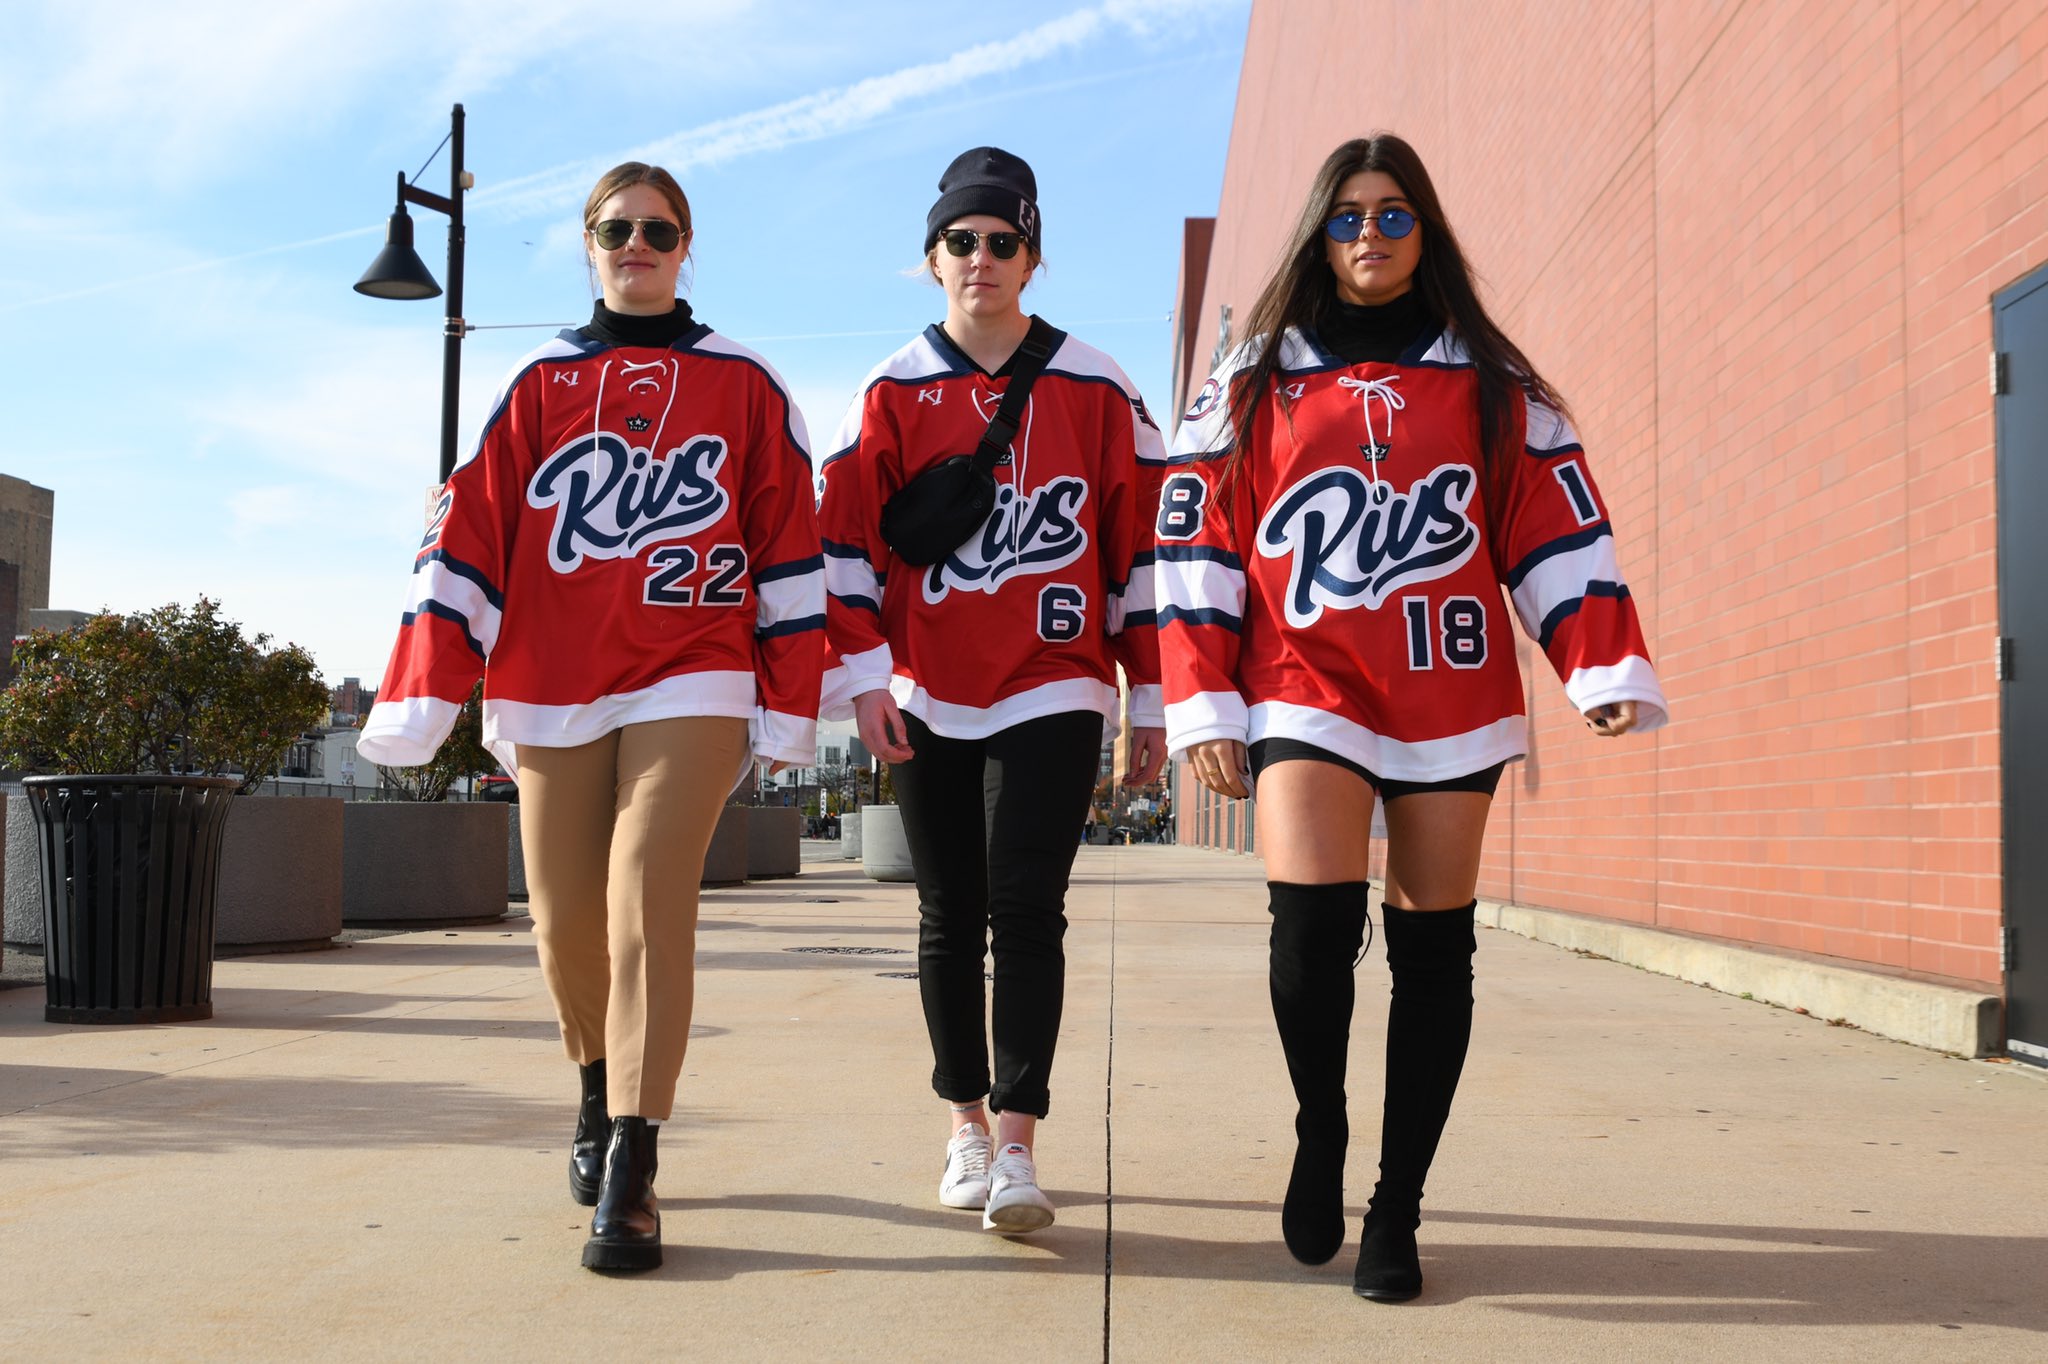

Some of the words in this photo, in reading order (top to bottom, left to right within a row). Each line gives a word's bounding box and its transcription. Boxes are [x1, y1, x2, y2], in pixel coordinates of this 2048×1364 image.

[553, 371, 579, 386] K1
[918, 388, 943, 406] K1
[527, 432, 729, 574] Rivs
[1155, 472, 1208, 541] 8
[642, 543, 748, 607] 22
[1257, 463, 1480, 629] Rivs
[1037, 583, 1087, 642] 6
[1403, 596, 1487, 671] 18
